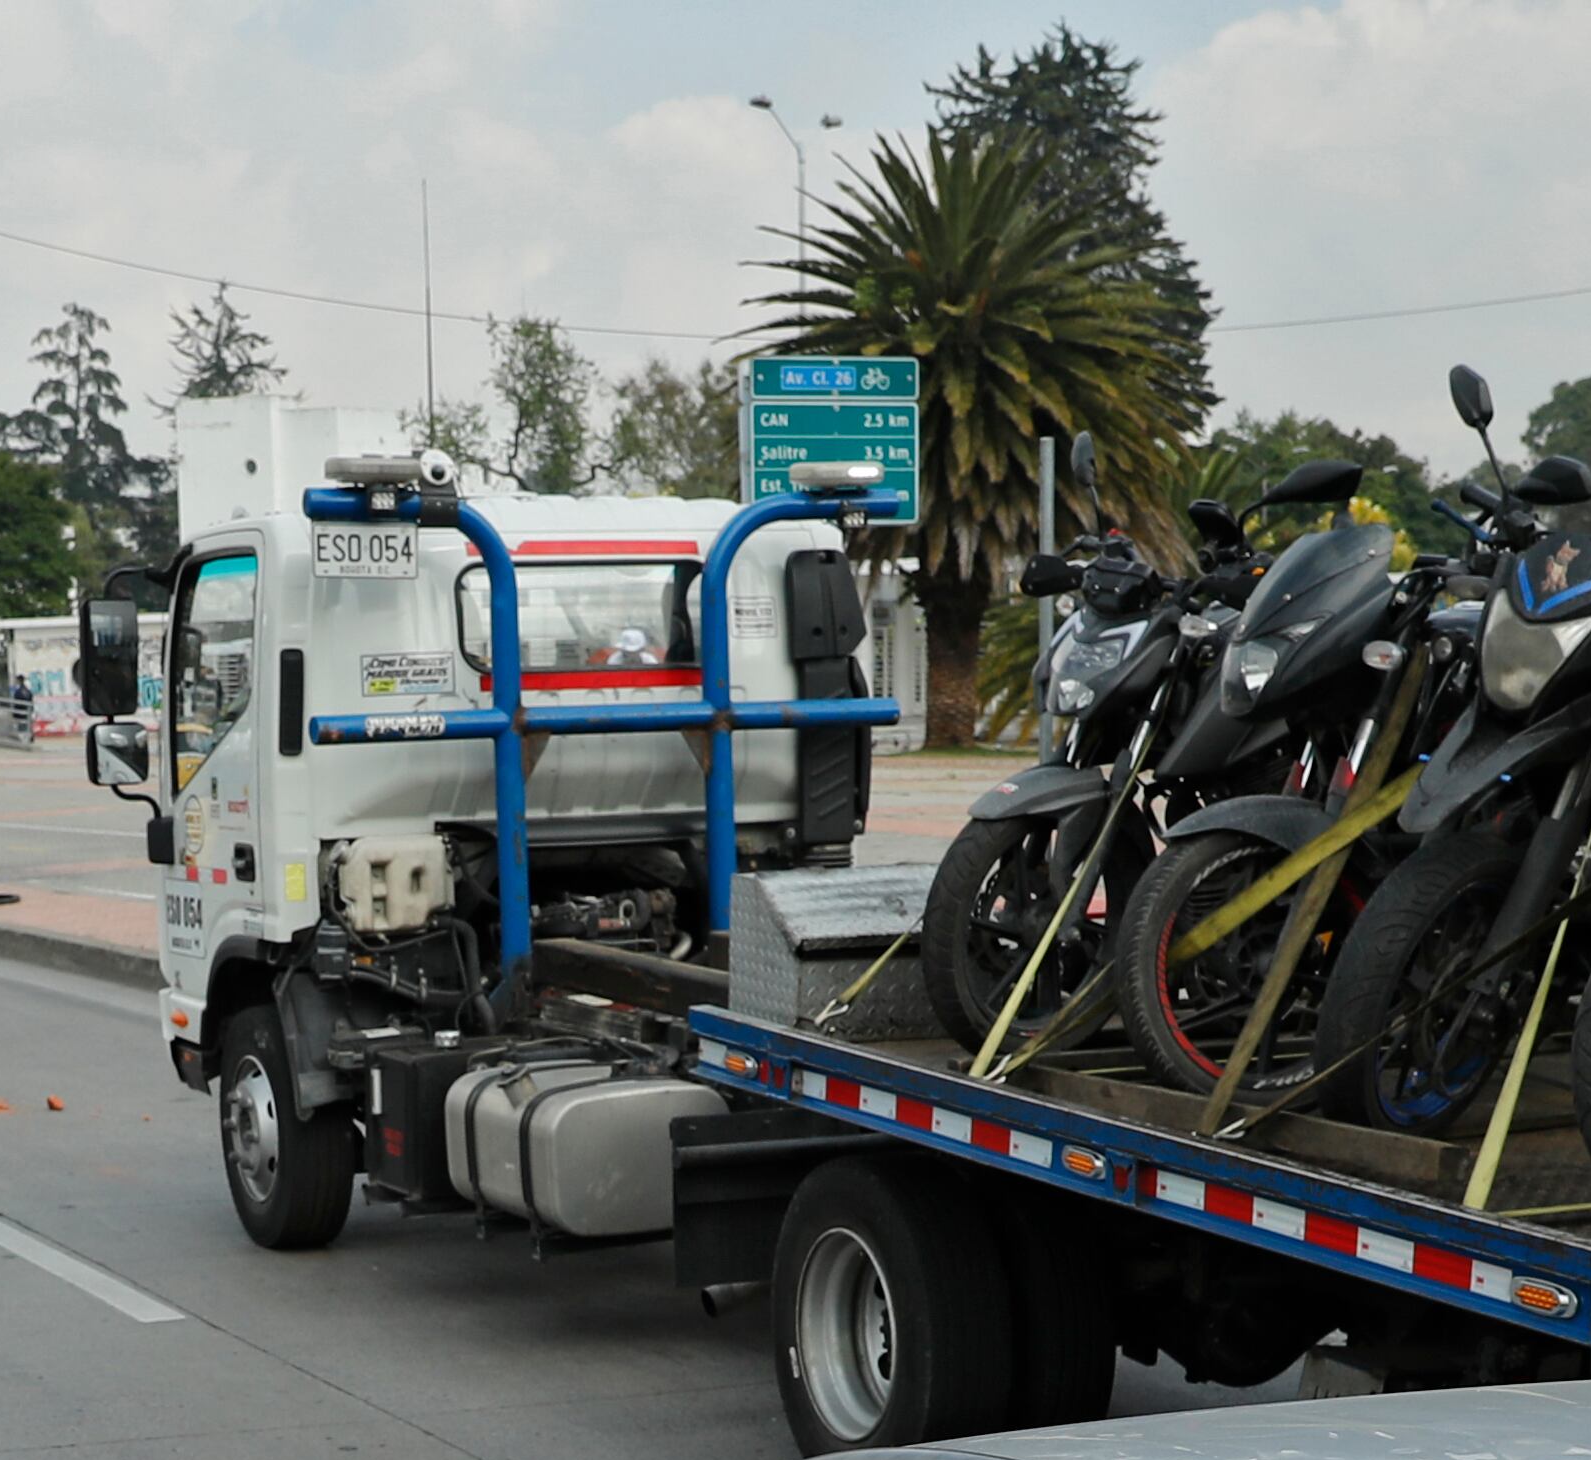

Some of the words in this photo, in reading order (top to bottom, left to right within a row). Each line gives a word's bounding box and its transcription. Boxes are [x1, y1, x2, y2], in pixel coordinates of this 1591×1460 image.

[785, 371, 806, 385] Av.
[835, 371, 852, 385] 26
[760, 413, 789, 427] CAN
[863, 413, 884, 427] 2.5
[888, 413, 910, 427] km
[760, 446, 808, 460] Salitre
[864, 446, 884, 460] 3.5
[888, 446, 910, 460] km
[760, 478, 786, 493] Est.
[369, 534, 414, 564] 054
